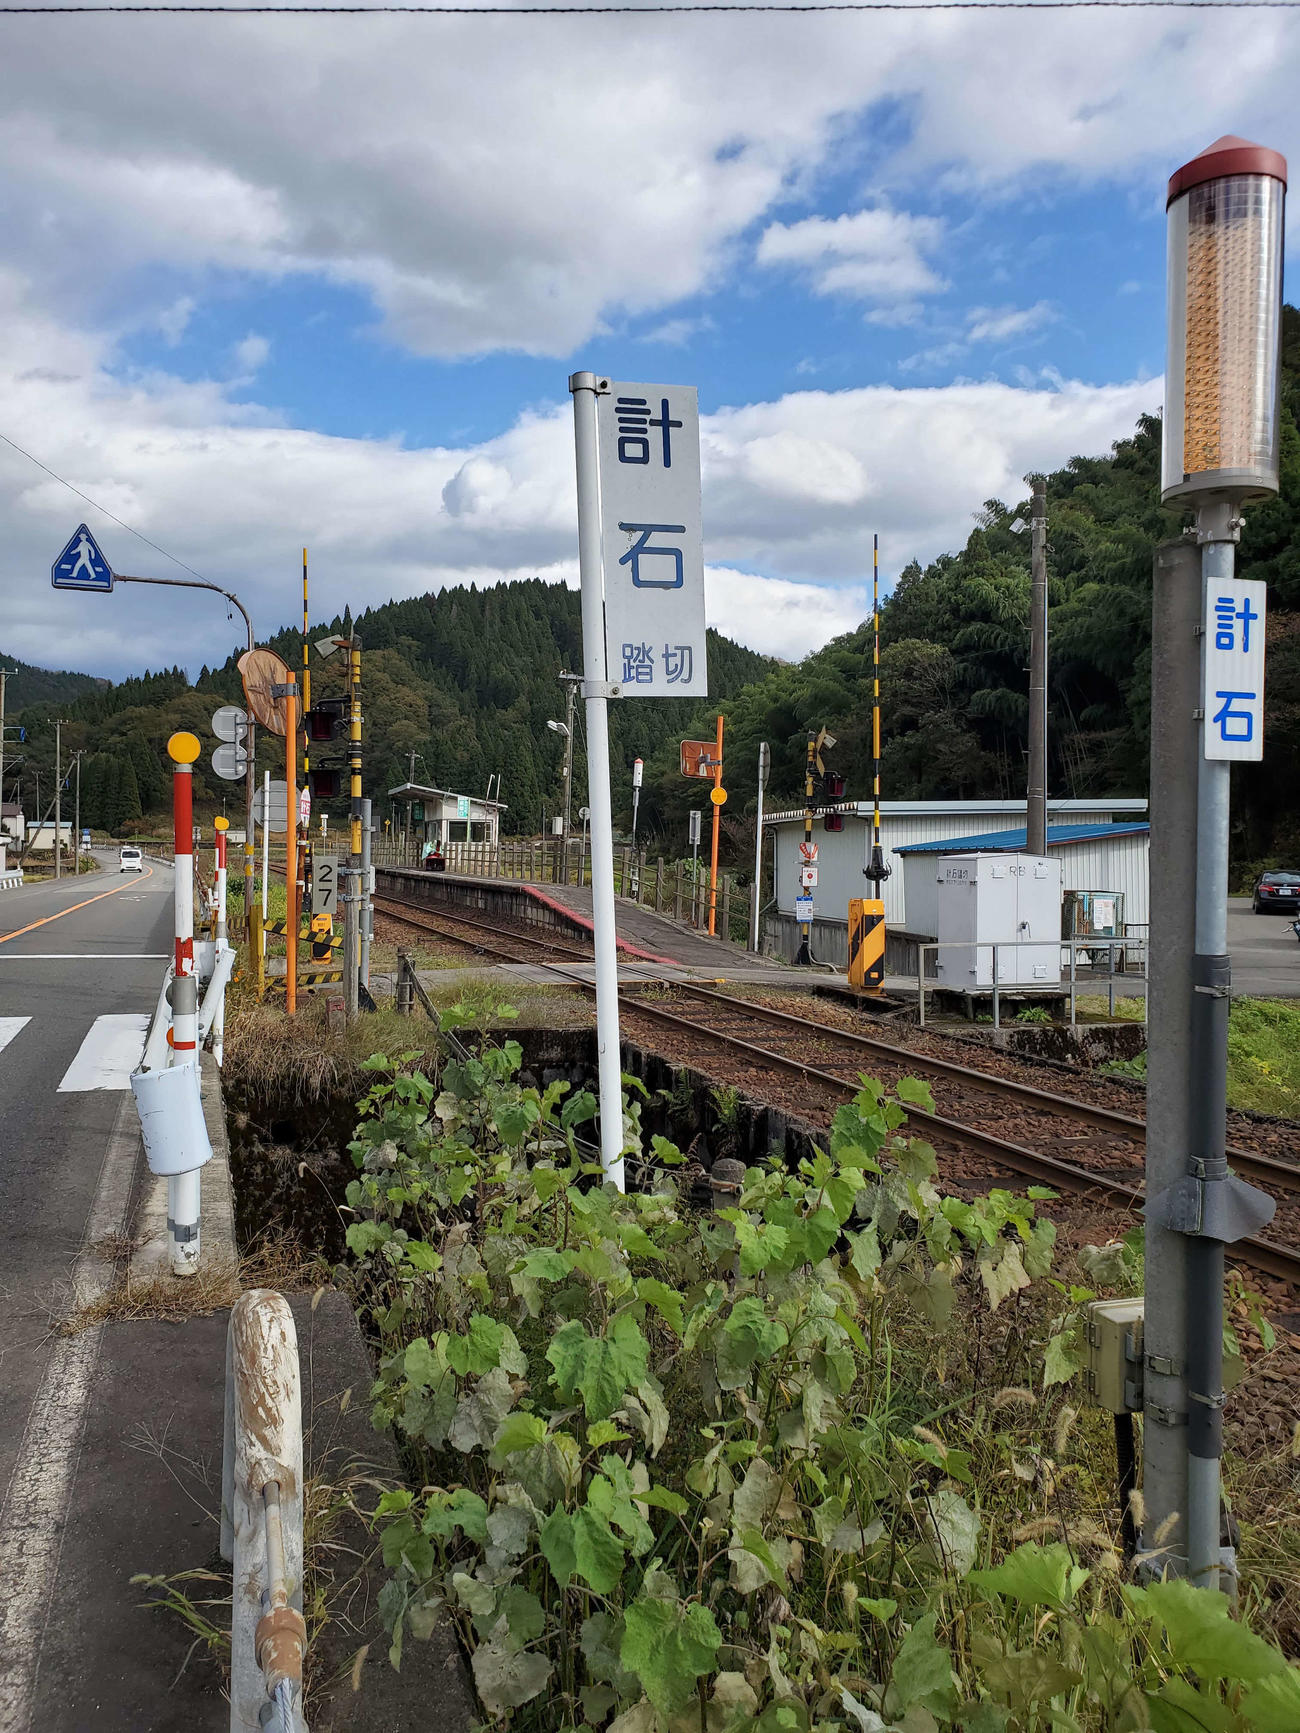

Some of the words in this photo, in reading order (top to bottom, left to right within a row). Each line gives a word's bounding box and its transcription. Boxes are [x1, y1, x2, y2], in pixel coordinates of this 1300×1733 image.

[615, 397, 686, 589] 計石
[622, 642, 692, 684] 踏切
[1213, 597, 1258, 742] 計石
